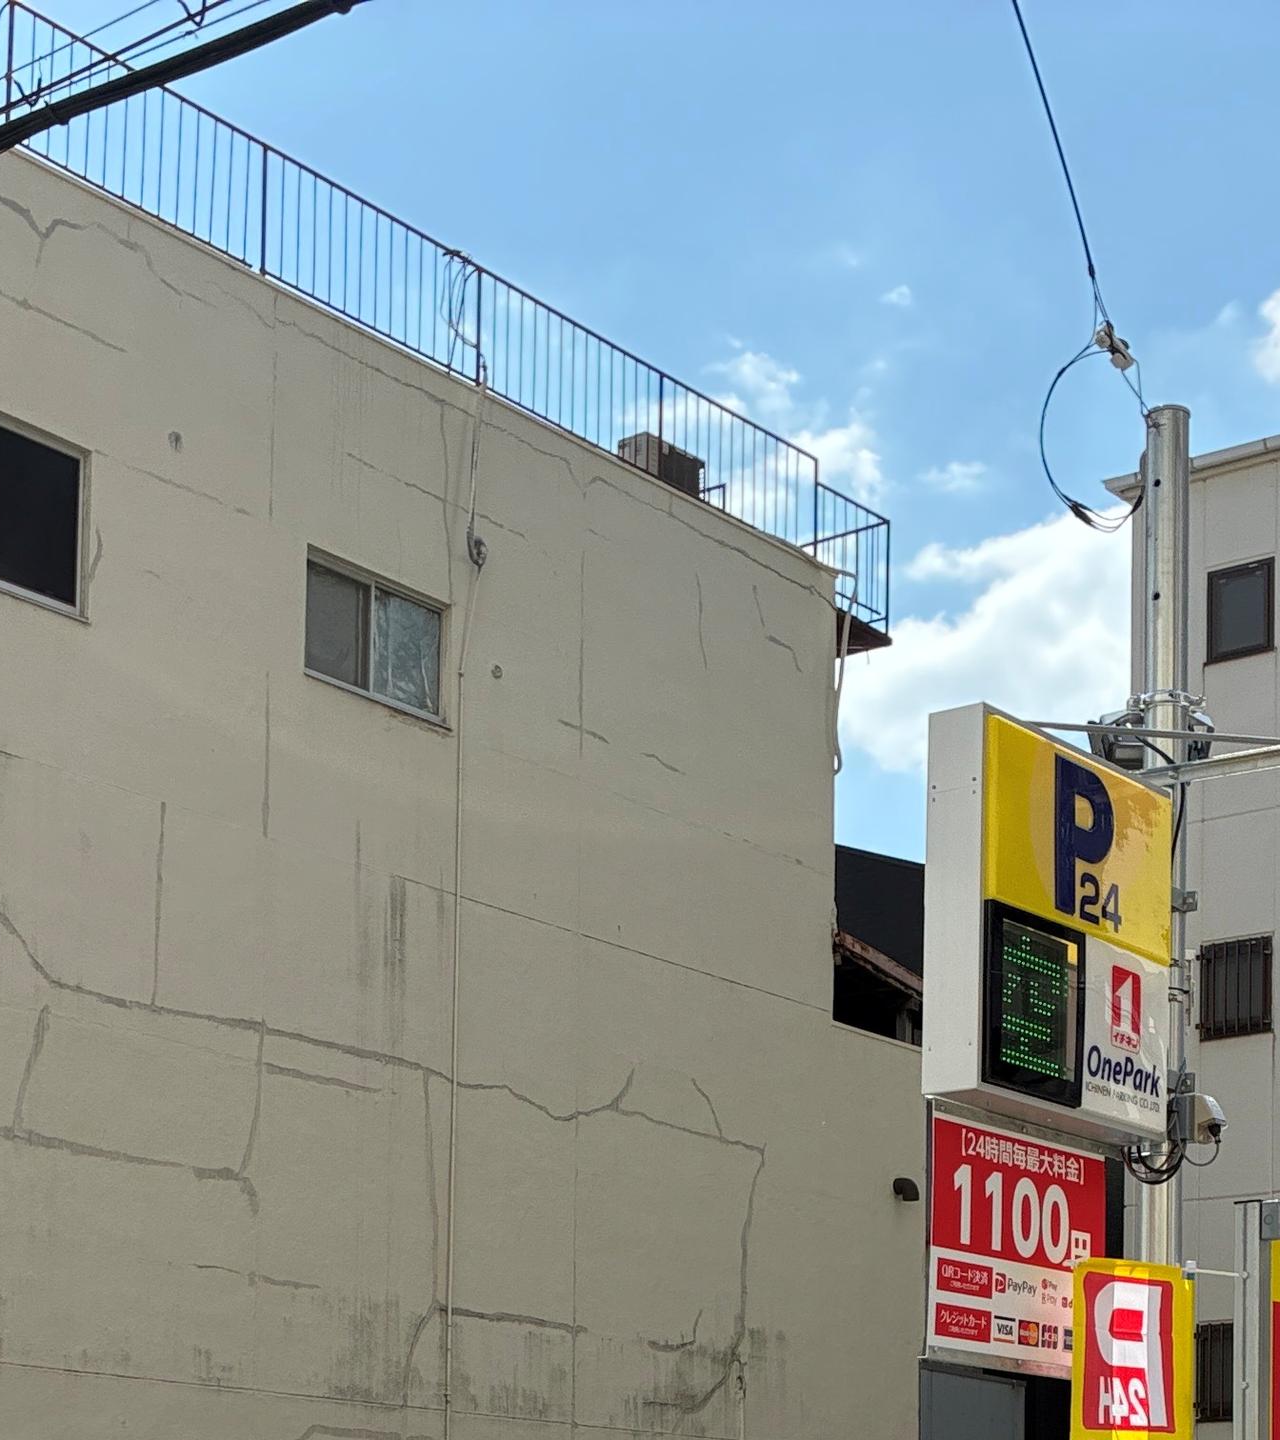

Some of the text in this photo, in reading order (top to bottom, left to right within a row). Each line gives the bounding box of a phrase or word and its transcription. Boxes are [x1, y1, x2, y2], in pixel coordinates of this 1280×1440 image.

[1055, 752, 1114, 917] P
[1079, 872, 1122, 933] 24
[1088, 1045, 1160, 1097] OnePark
[1007, 1278, 1038, 1297] PayPay
[940, 1309, 988, 1329] クレジットカード
[997, 1323, 1014, 1337] VISA
